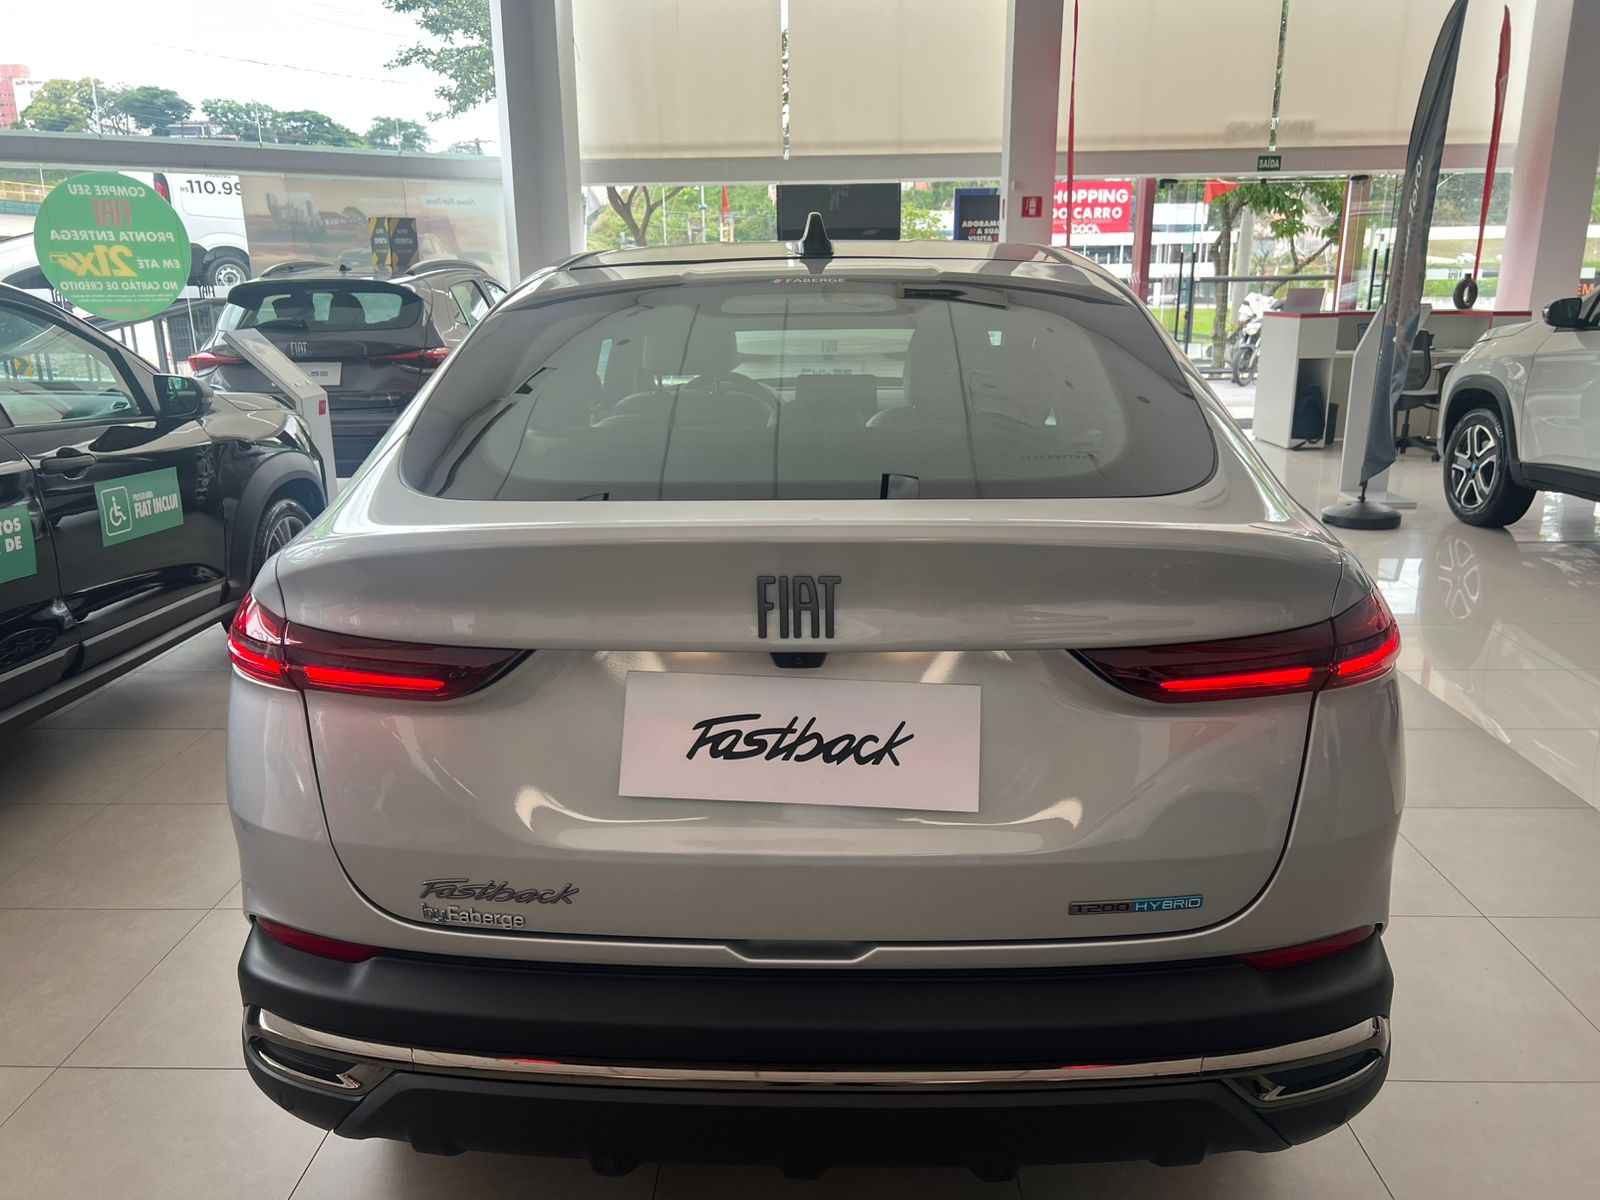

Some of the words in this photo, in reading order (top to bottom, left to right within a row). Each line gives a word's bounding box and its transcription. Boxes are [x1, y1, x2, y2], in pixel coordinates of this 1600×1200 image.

[1259, 157, 1280, 169] SAÍDA
[1053, 189, 1129, 205] HOPPING
[1073, 207, 1123, 219] CARRO
[134, 499, 152, 519] FIAT
[152, 493, 179, 515] INCLUI
[0, 517, 22, 536] OS
[5, 535, 23, 553] DE
[756, 575, 842, 639] FIAT
[686, 713, 915, 767] Fastback
[419, 877, 580, 905] Fastback
[421, 902, 447, 923] by
[447, 904, 526, 929] Faberge
[1072, 902, 1130, 914] T200
[1135, 898, 1201, 912] HYBRID
